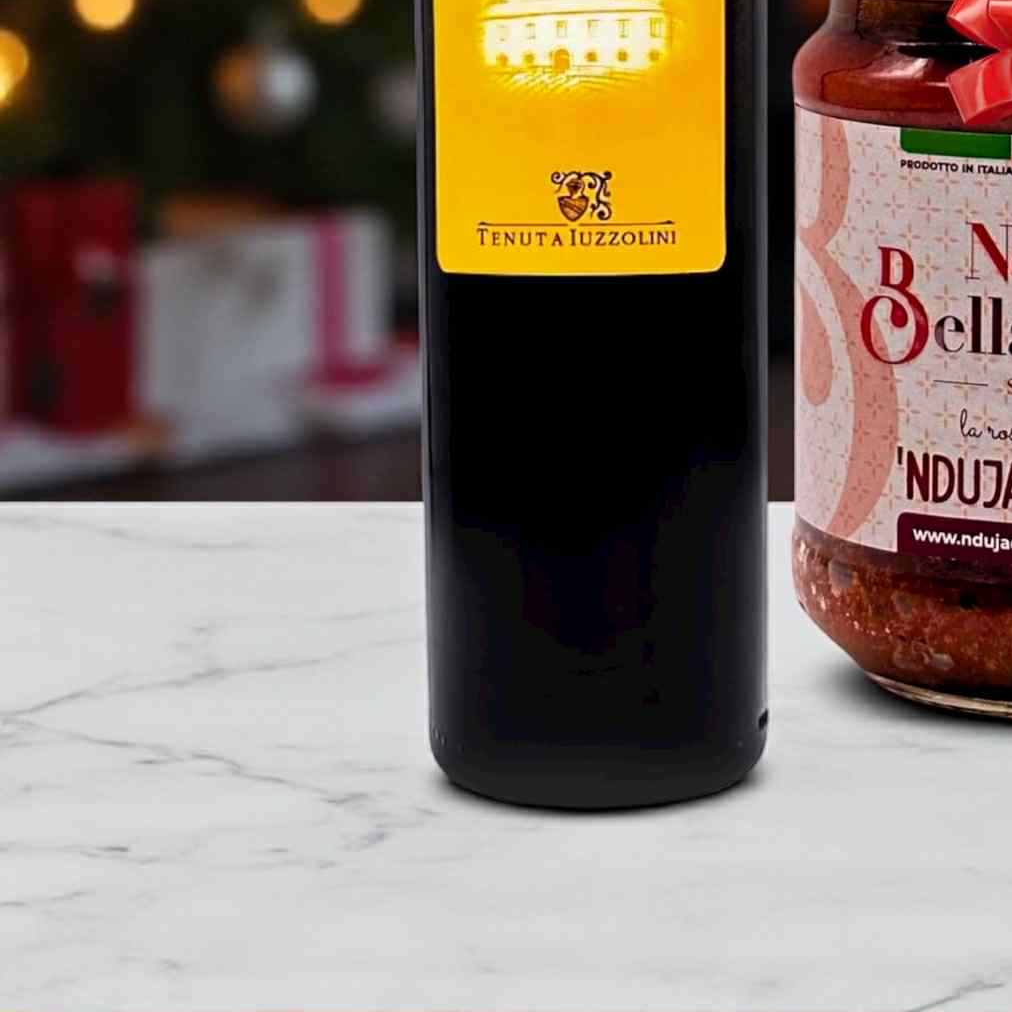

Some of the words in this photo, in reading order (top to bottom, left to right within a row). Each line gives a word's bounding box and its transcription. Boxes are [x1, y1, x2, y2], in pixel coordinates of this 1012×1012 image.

[900, 159, 959, 173] PRODOTTO
[962, 164, 974, 174] IN
[476, 228, 564, 247] TENUTA
[569, 228, 677, 247] IUZZOLINI
[959, 408, 982, 439] la
